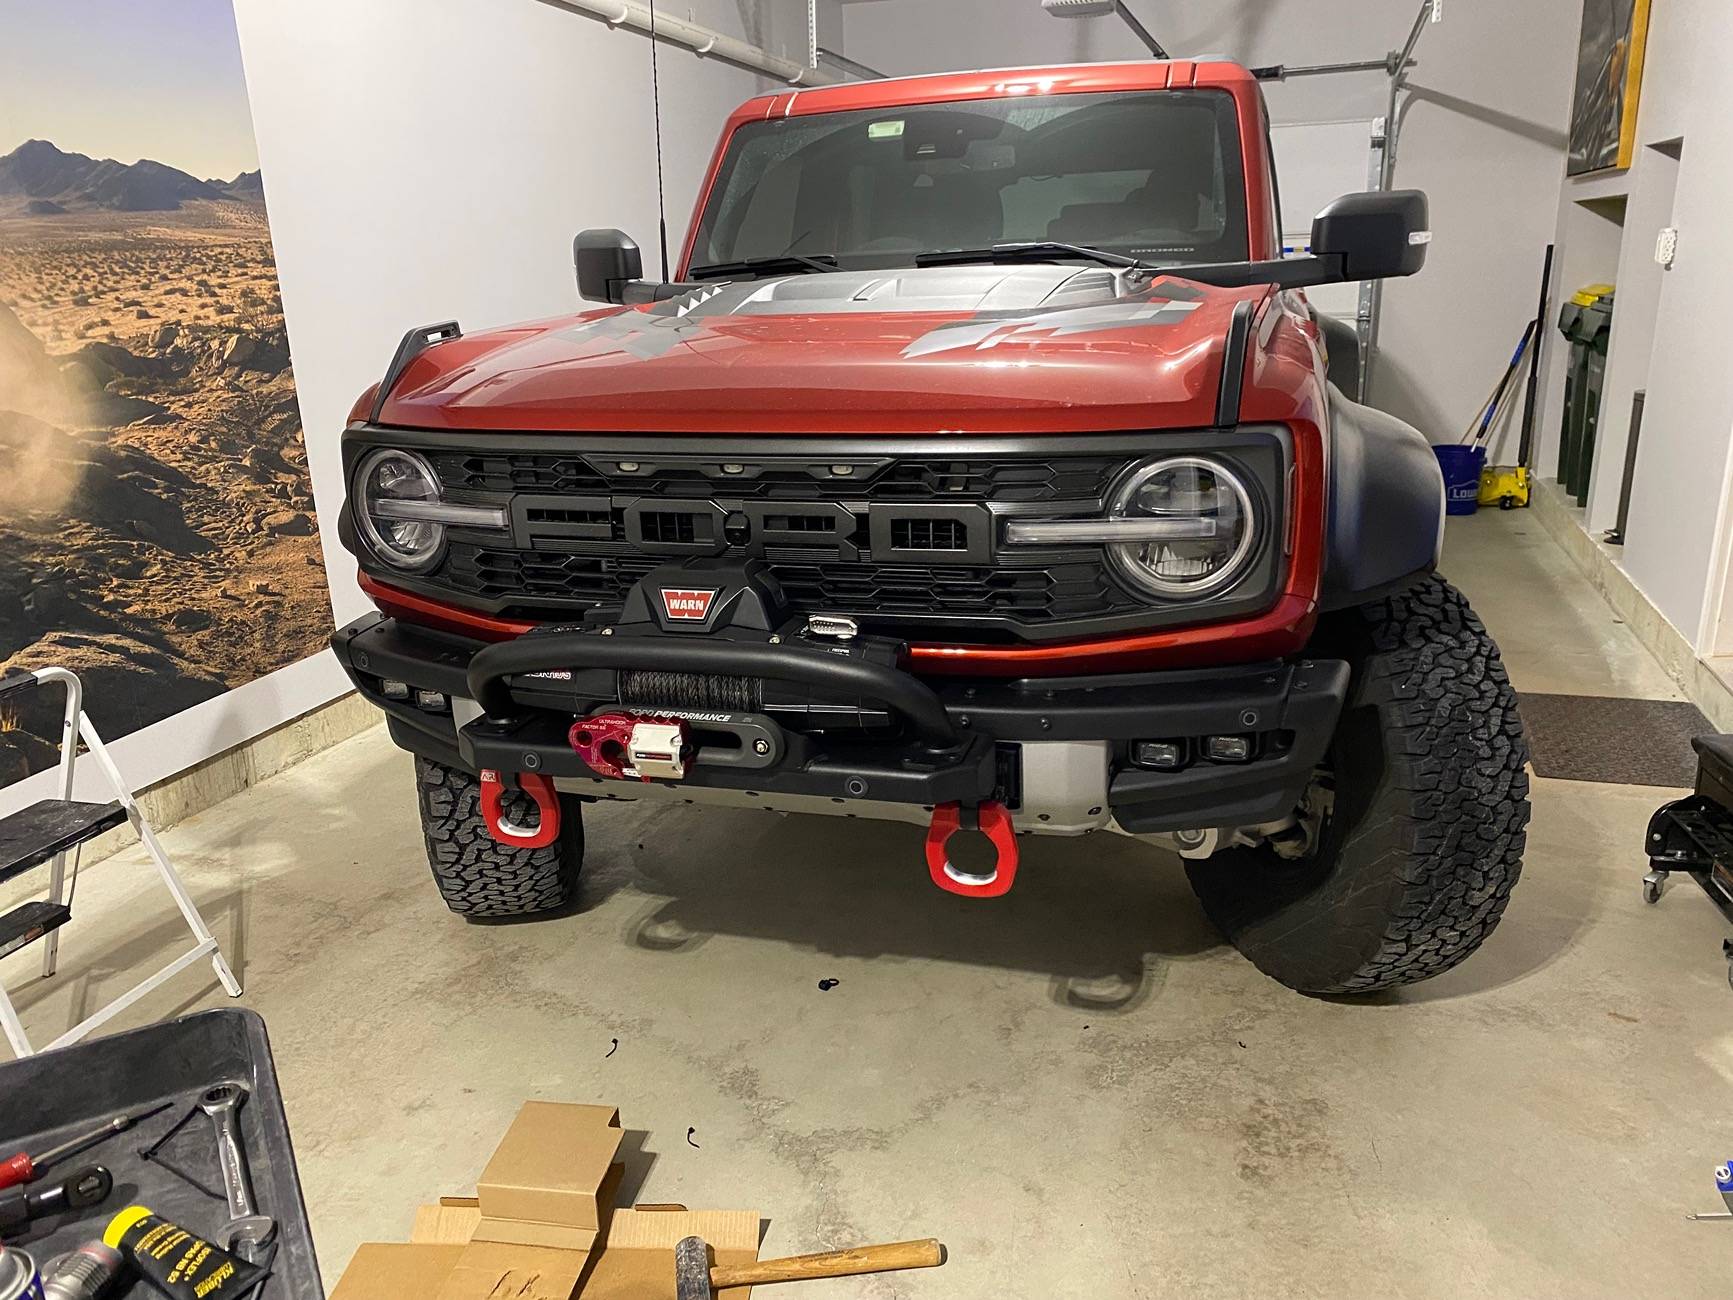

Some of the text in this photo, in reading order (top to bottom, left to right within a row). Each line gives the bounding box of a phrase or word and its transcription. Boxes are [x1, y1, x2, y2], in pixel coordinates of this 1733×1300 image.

[511, 494, 993, 565] FORD
[669, 598, 704, 611] WARN
[654, 710, 732, 722] PERFORMANCE
